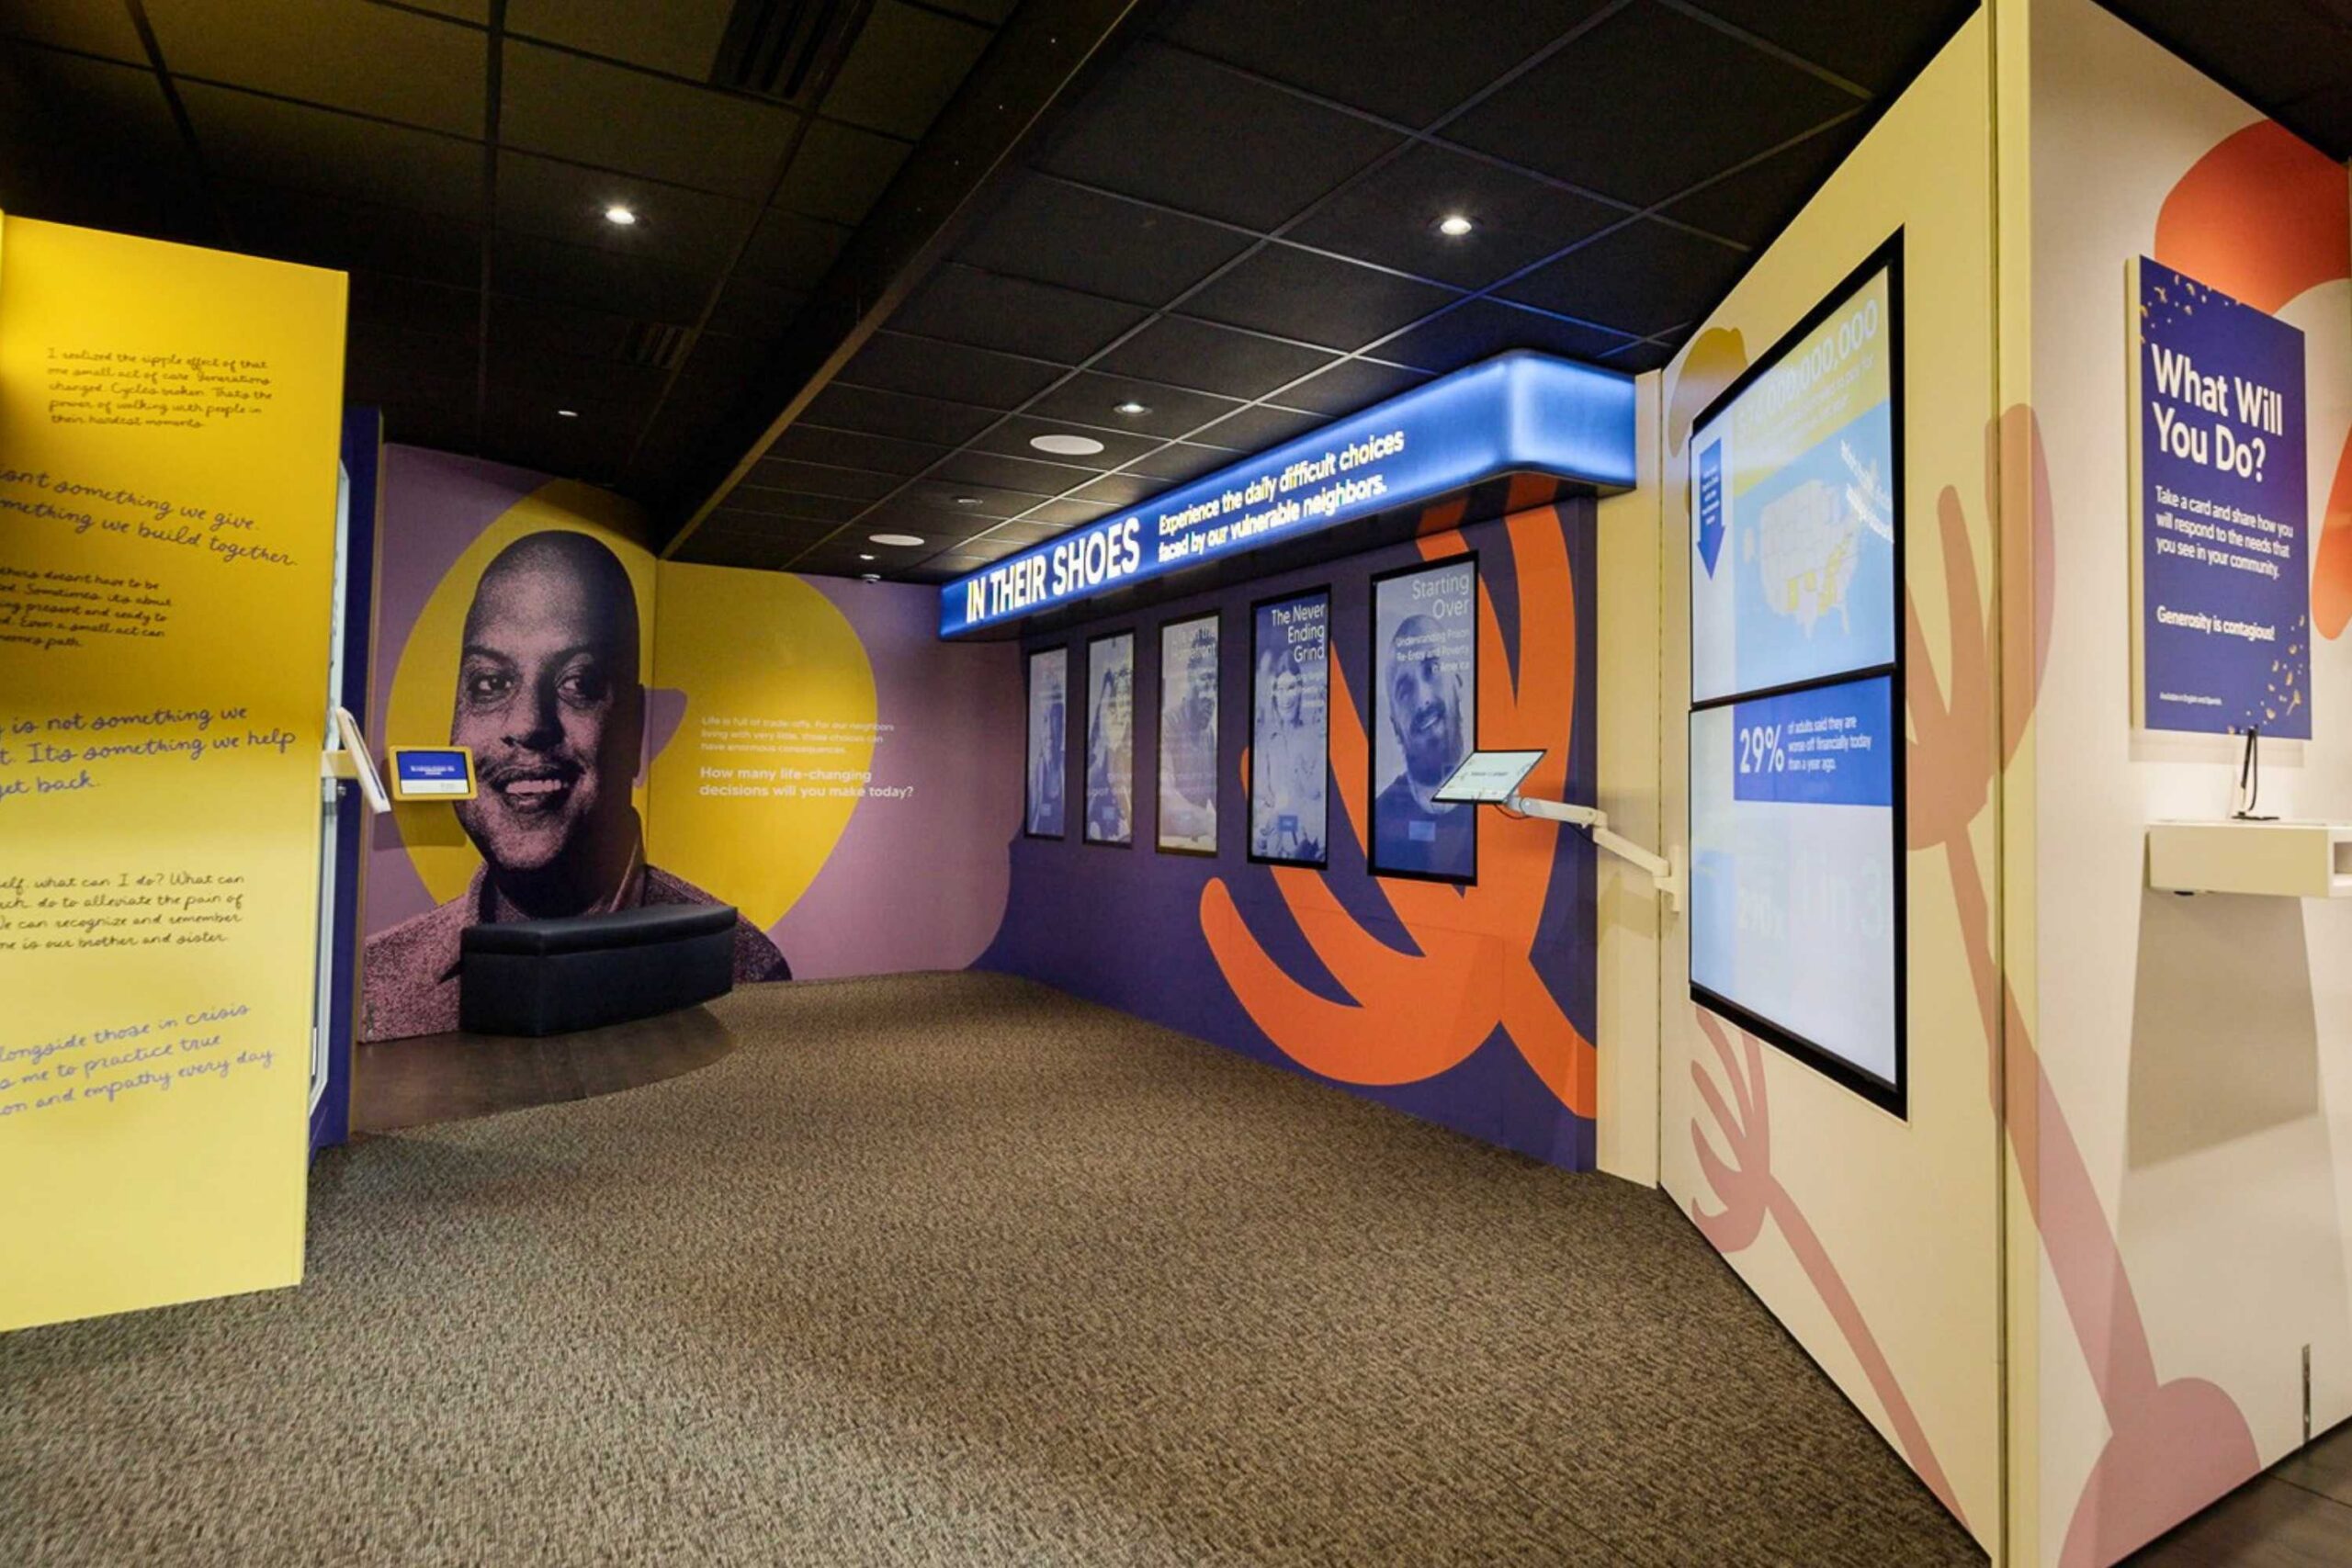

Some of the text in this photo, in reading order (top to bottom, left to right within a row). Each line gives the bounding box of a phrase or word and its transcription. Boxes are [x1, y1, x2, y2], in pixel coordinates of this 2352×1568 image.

[2151, 343, 2283, 436] What Will
[2152, 401, 2267, 482] You Do?
[1159, 430, 1405, 536] Experience the daily difficult choices
[53, 481, 174, 521] something
[180, 506, 206, 521] we
[2155, 485, 2294, 538] Take a card and share how you
[102, 519, 130, 534] we
[138, 521, 201, 547] build
[1159, 474, 1387, 563] faced by our vulnerable neighbors.
[2155, 512, 2290, 558] will respond to the needs that
[967, 516, 1140, 625] IN THEIR SHOES
[2155, 537, 2280, 580] you see in your community.
[1412, 574, 1469, 600] Starting
[1272, 604, 1325, 626] The Never
[1432, 599, 1469, 619] Over
[2157, 604, 2211, 635] Generosity
[2213, 615, 2222, 632] is
[1287, 624, 1325, 644] Ending
[1294, 643, 1325, 662] Grind
[47, 712, 86, 730] not
[91, 706, 215, 730] something
[220, 706, 247, 720] we
[83, 736, 207, 761] something
[213, 735, 239, 748] we
[247, 728, 296, 753] help
[1739, 724, 1785, 773] 29%
[699, 767, 872, 783] How many life-changing
[699, 784, 914, 799] decisions will you make today?
[34, 871, 244, 889] what can I do? What can
[38, 893, 244, 910] do to alleviate the pain of
[17, 912, 242, 933] can recognize and remember
[21, 938, 40, 951] is
[46, 938, 74, 949] our
[77, 935, 139, 949] brother
[141, 933, 172, 944] and
[94, 1002, 251, 1043] those in crisis
[21, 1035, 221, 1084] me to practice true
[35, 1049, 274, 1110] and empathy every day
